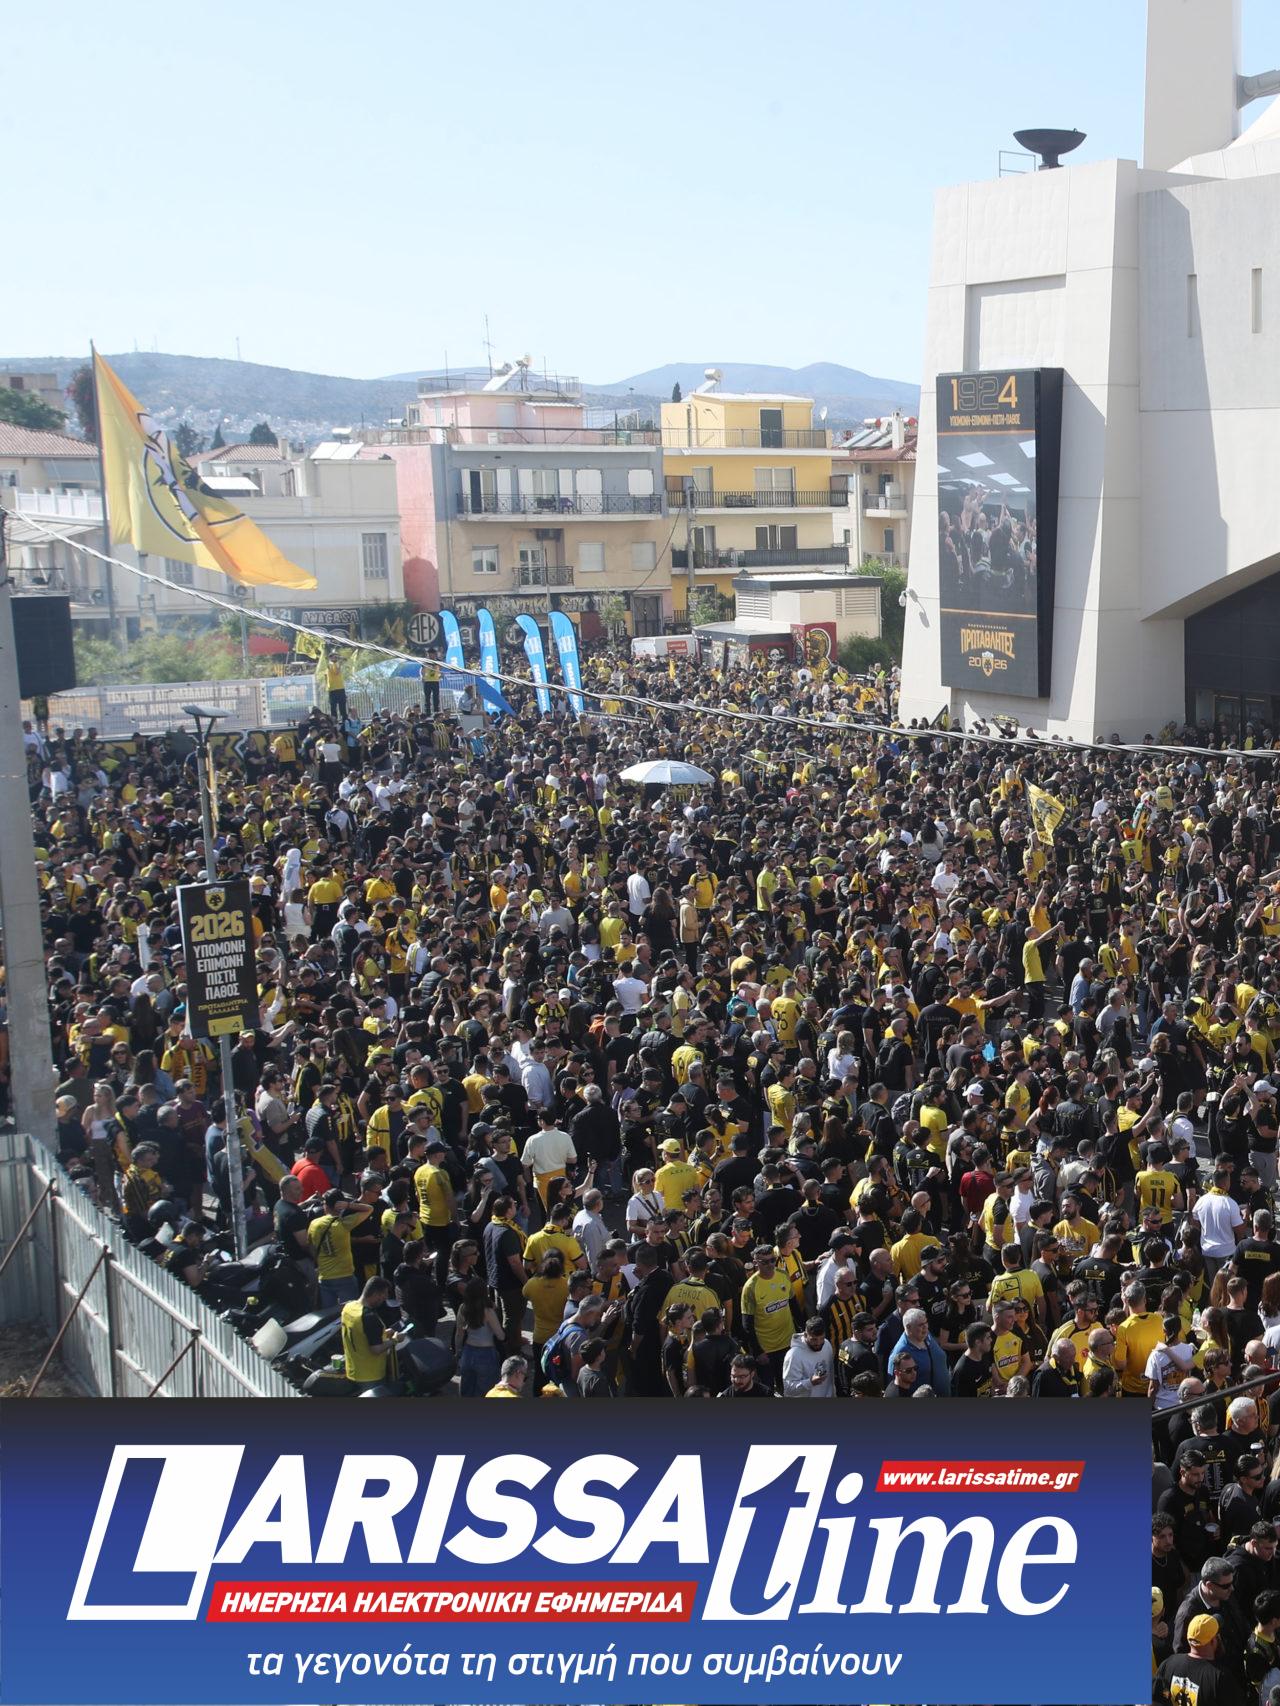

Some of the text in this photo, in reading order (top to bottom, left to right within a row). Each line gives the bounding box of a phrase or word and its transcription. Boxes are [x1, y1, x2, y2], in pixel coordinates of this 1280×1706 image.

[950, 374, 1018, 411] 1924
[190, 909, 245, 942] 2026
[193, 939, 246, 959] ΥΠΟΜΟΝΗ
[197, 953, 244, 973] ΕΠΙΜΟΝΗ
[206, 969, 237, 986] ΠΙΣΤΗ
[205, 983, 240, 1001] ΠΑΘΟΣ
